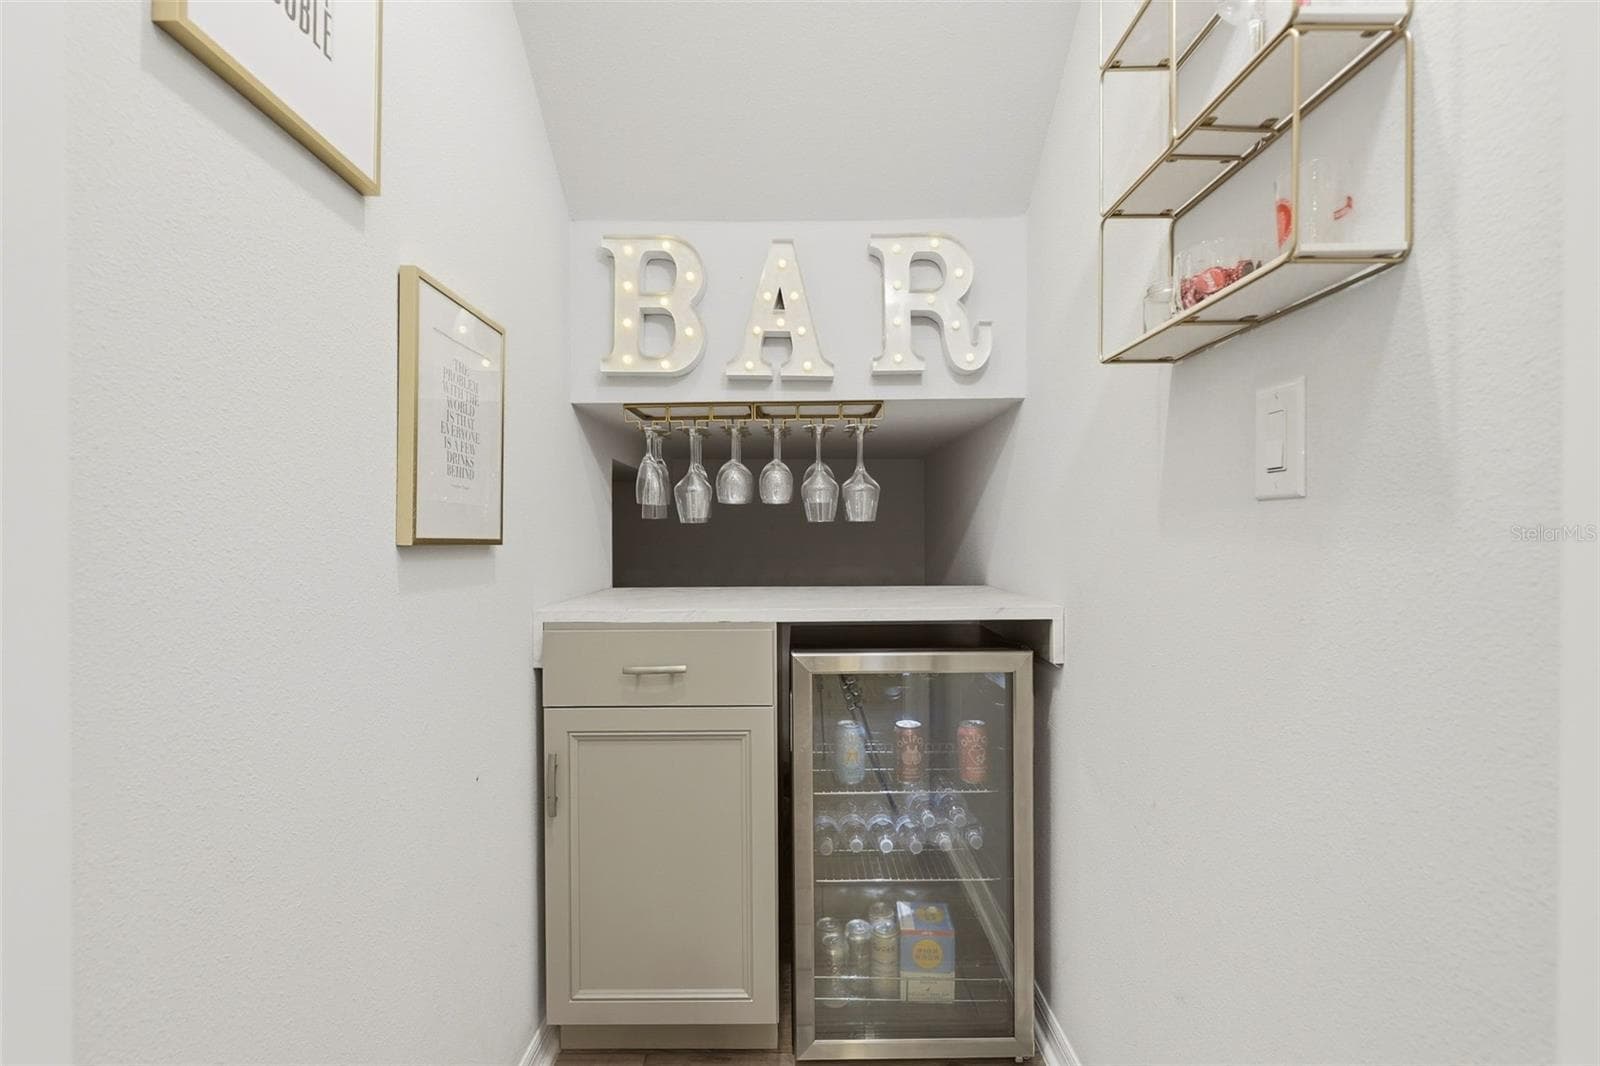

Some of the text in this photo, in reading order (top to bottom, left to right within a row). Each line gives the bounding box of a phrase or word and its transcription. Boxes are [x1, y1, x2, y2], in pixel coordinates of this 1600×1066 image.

[600, 233, 993, 381] BAR
[453, 359, 470, 377] THE
[443, 367, 479, 394] PROBLEM
[443, 381, 479, 407] WITH THE
[447, 398, 476, 418] WORLD
[446, 409, 475, 430] IS THAT
[440, 421, 481, 445] EVERYONE
[444, 436, 452, 450] IS
[460, 441, 476, 456] FEW
[446, 451, 475, 469] DRINKS
[446, 464, 475, 481] BEHIND
